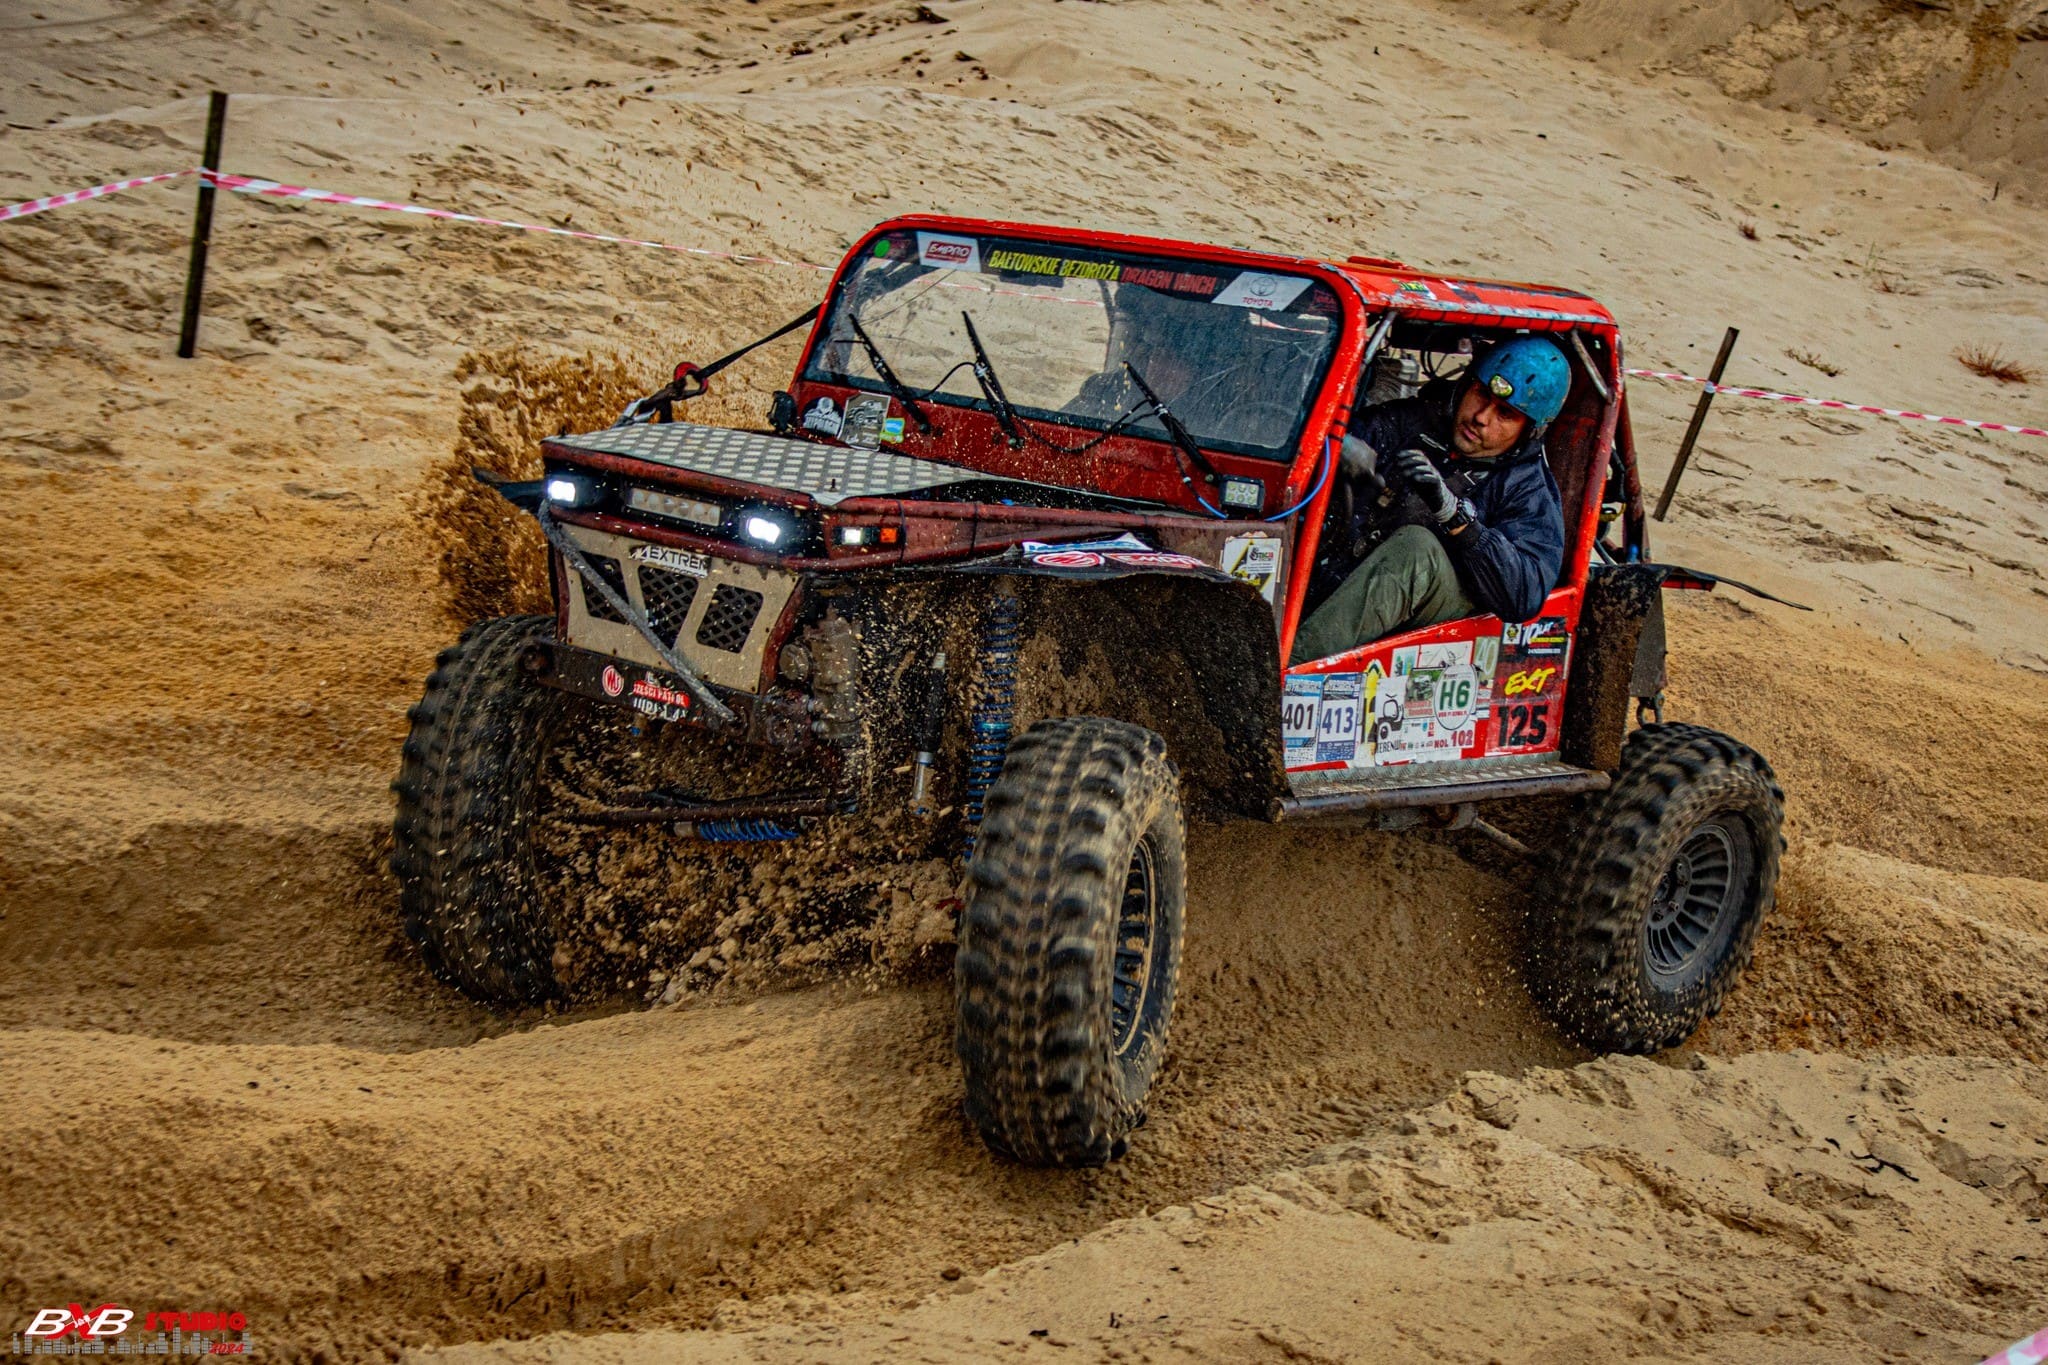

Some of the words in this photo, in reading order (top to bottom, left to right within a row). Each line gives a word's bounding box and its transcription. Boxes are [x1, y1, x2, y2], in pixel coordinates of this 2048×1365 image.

[989, 250, 1062, 275] BAŁTOWSKIE
[1059, 259, 1121, 280] BEZDROŻA
[1120, 267, 1174, 289] DRAGON
[1173, 272, 1217, 295] WINCH
[1242, 296, 1273, 307] TOYOTA
[1504, 667, 1556, 695] EXT
[1440, 680, 1470, 711] H6
[1282, 703, 1314, 730] 401
[1322, 706, 1354, 734] 413
[1498, 705, 1548, 746] 125
[1451, 730, 1474, 747] 102
